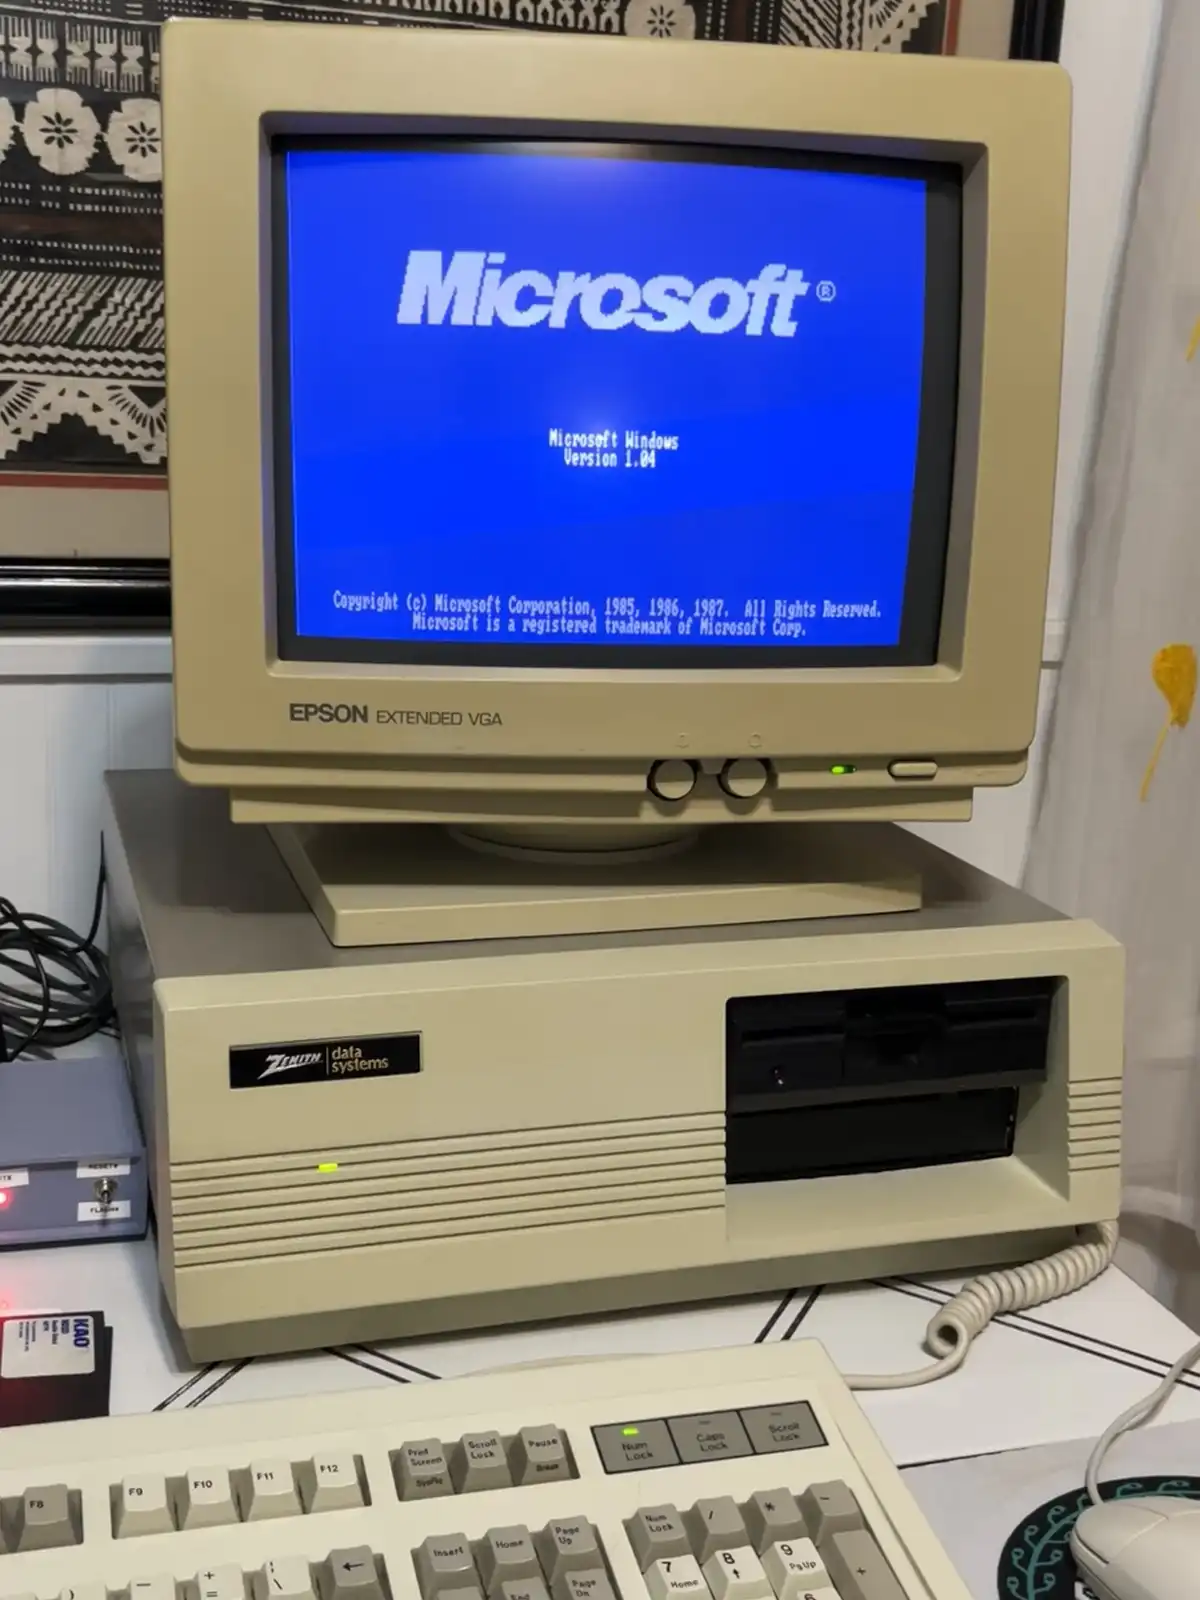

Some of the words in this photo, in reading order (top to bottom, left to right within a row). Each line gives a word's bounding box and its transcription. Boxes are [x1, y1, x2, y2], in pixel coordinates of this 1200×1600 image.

[397, 250, 810, 337] Microsoft
[549, 428, 618, 448] Microsoft
[624, 430, 679, 450] Windows
[564, 448, 617, 467] Version
[624, 449, 656, 468] 1.04
[333, 590, 398, 612] Copyright
[406, 593, 427, 611] (c)
[434, 593, 500, 613] Microsoft
[508, 595, 596, 617] Corporation,
[604, 597, 640, 617] 1985,
[649, 598, 685, 618] 1986,
[744, 599, 766, 617] All
[773, 600, 817, 620] Rights
[822, 600, 882, 618] Reserved.
[412, 612, 478, 631] Microsoft
[486, 614, 500, 632] is
[508, 618, 516, 632] a
[522, 615, 597, 635] registered
[604, 616, 672, 634] trademark
[678, 617, 692, 634] of
[700, 617, 766, 636] Microsoft
[772, 618, 806, 638] Corp.
[289, 703, 368, 723] EPSON
[376, 710, 463, 726] EXTENDED
[468, 712, 503, 726] VGA
[332, 1046, 362, 1060] data
[257, 1052, 323, 1080] ZENITH
[332, 1057, 389, 1074] systems
[73, 1318, 90, 1349] KAO
[769, 1421, 801, 1434] Scroll
[697, 1431, 725, 1443] Caps
[773, 1432, 800, 1443] Lock
[468, 1438, 498, 1449] Scroll
[528, 1438, 558, 1448] Pause
[622, 1441, 648, 1451] Num
[701, 1441, 728, 1452] Lock
[471, 1450, 495, 1460] Lock
[626, 1451, 653, 1461] Lock
[411, 1456, 443, 1467] Screen
[319, 1464, 339, 1474] F12
[256, 1472, 274, 1482] F11
[193, 1480, 213, 1490] F10
[128, 1487, 143, 1496] F9
[29, 1500, 44, 1509] F8
[645, 1514, 668, 1523] Num
[556, 1526, 580, 1537] Page
[649, 1523, 674, 1533] Lock
[496, 1539, 524, 1549] Home
[558, 1536, 572, 1546] Up
[433, 1546, 464, 1558] Insert
[781, 1544, 793, 1556] 9
[722, 1552, 735, 1565] 8
[661, 1561, 672, 1573] 7
[789, 1560, 816, 1571] PgUp
[572, 1579, 597, 1589] Page
[670, 1578, 699, 1589] Home
